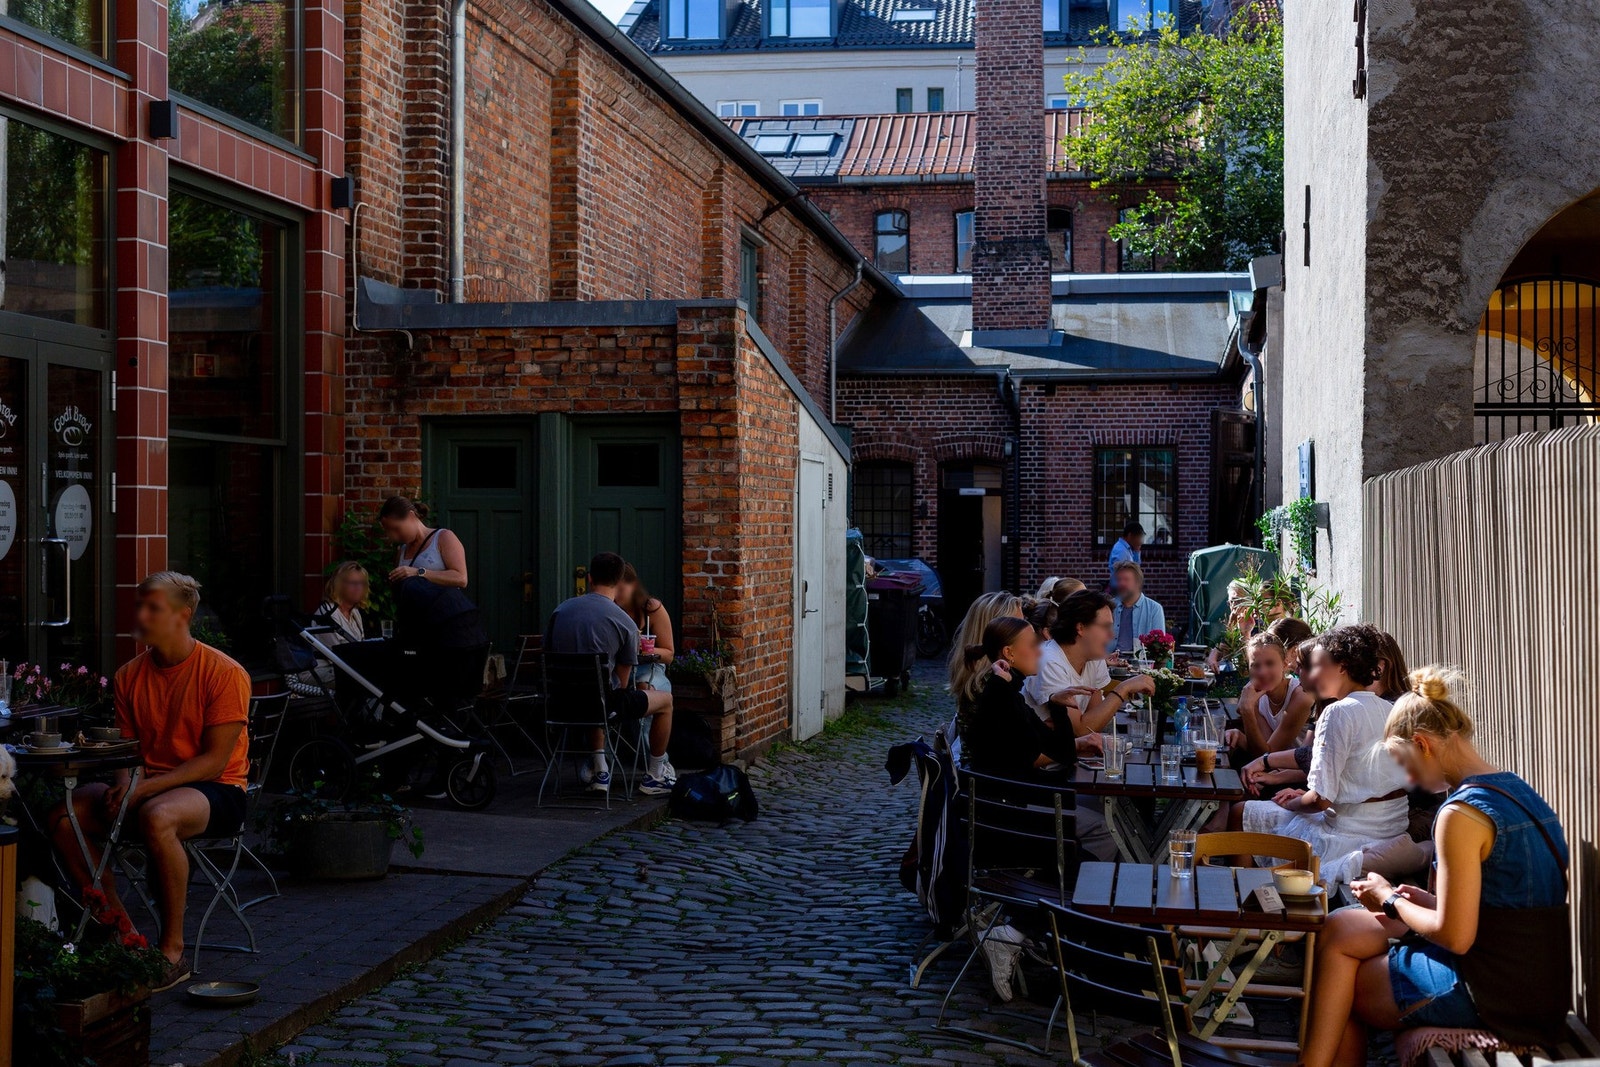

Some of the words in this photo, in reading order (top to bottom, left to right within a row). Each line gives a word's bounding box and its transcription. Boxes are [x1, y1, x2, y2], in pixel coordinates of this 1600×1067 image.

[53, 404, 72, 433] Godt
[73, 404, 93, 435] Brød
[55, 470, 82, 479] VELKOMMEN
